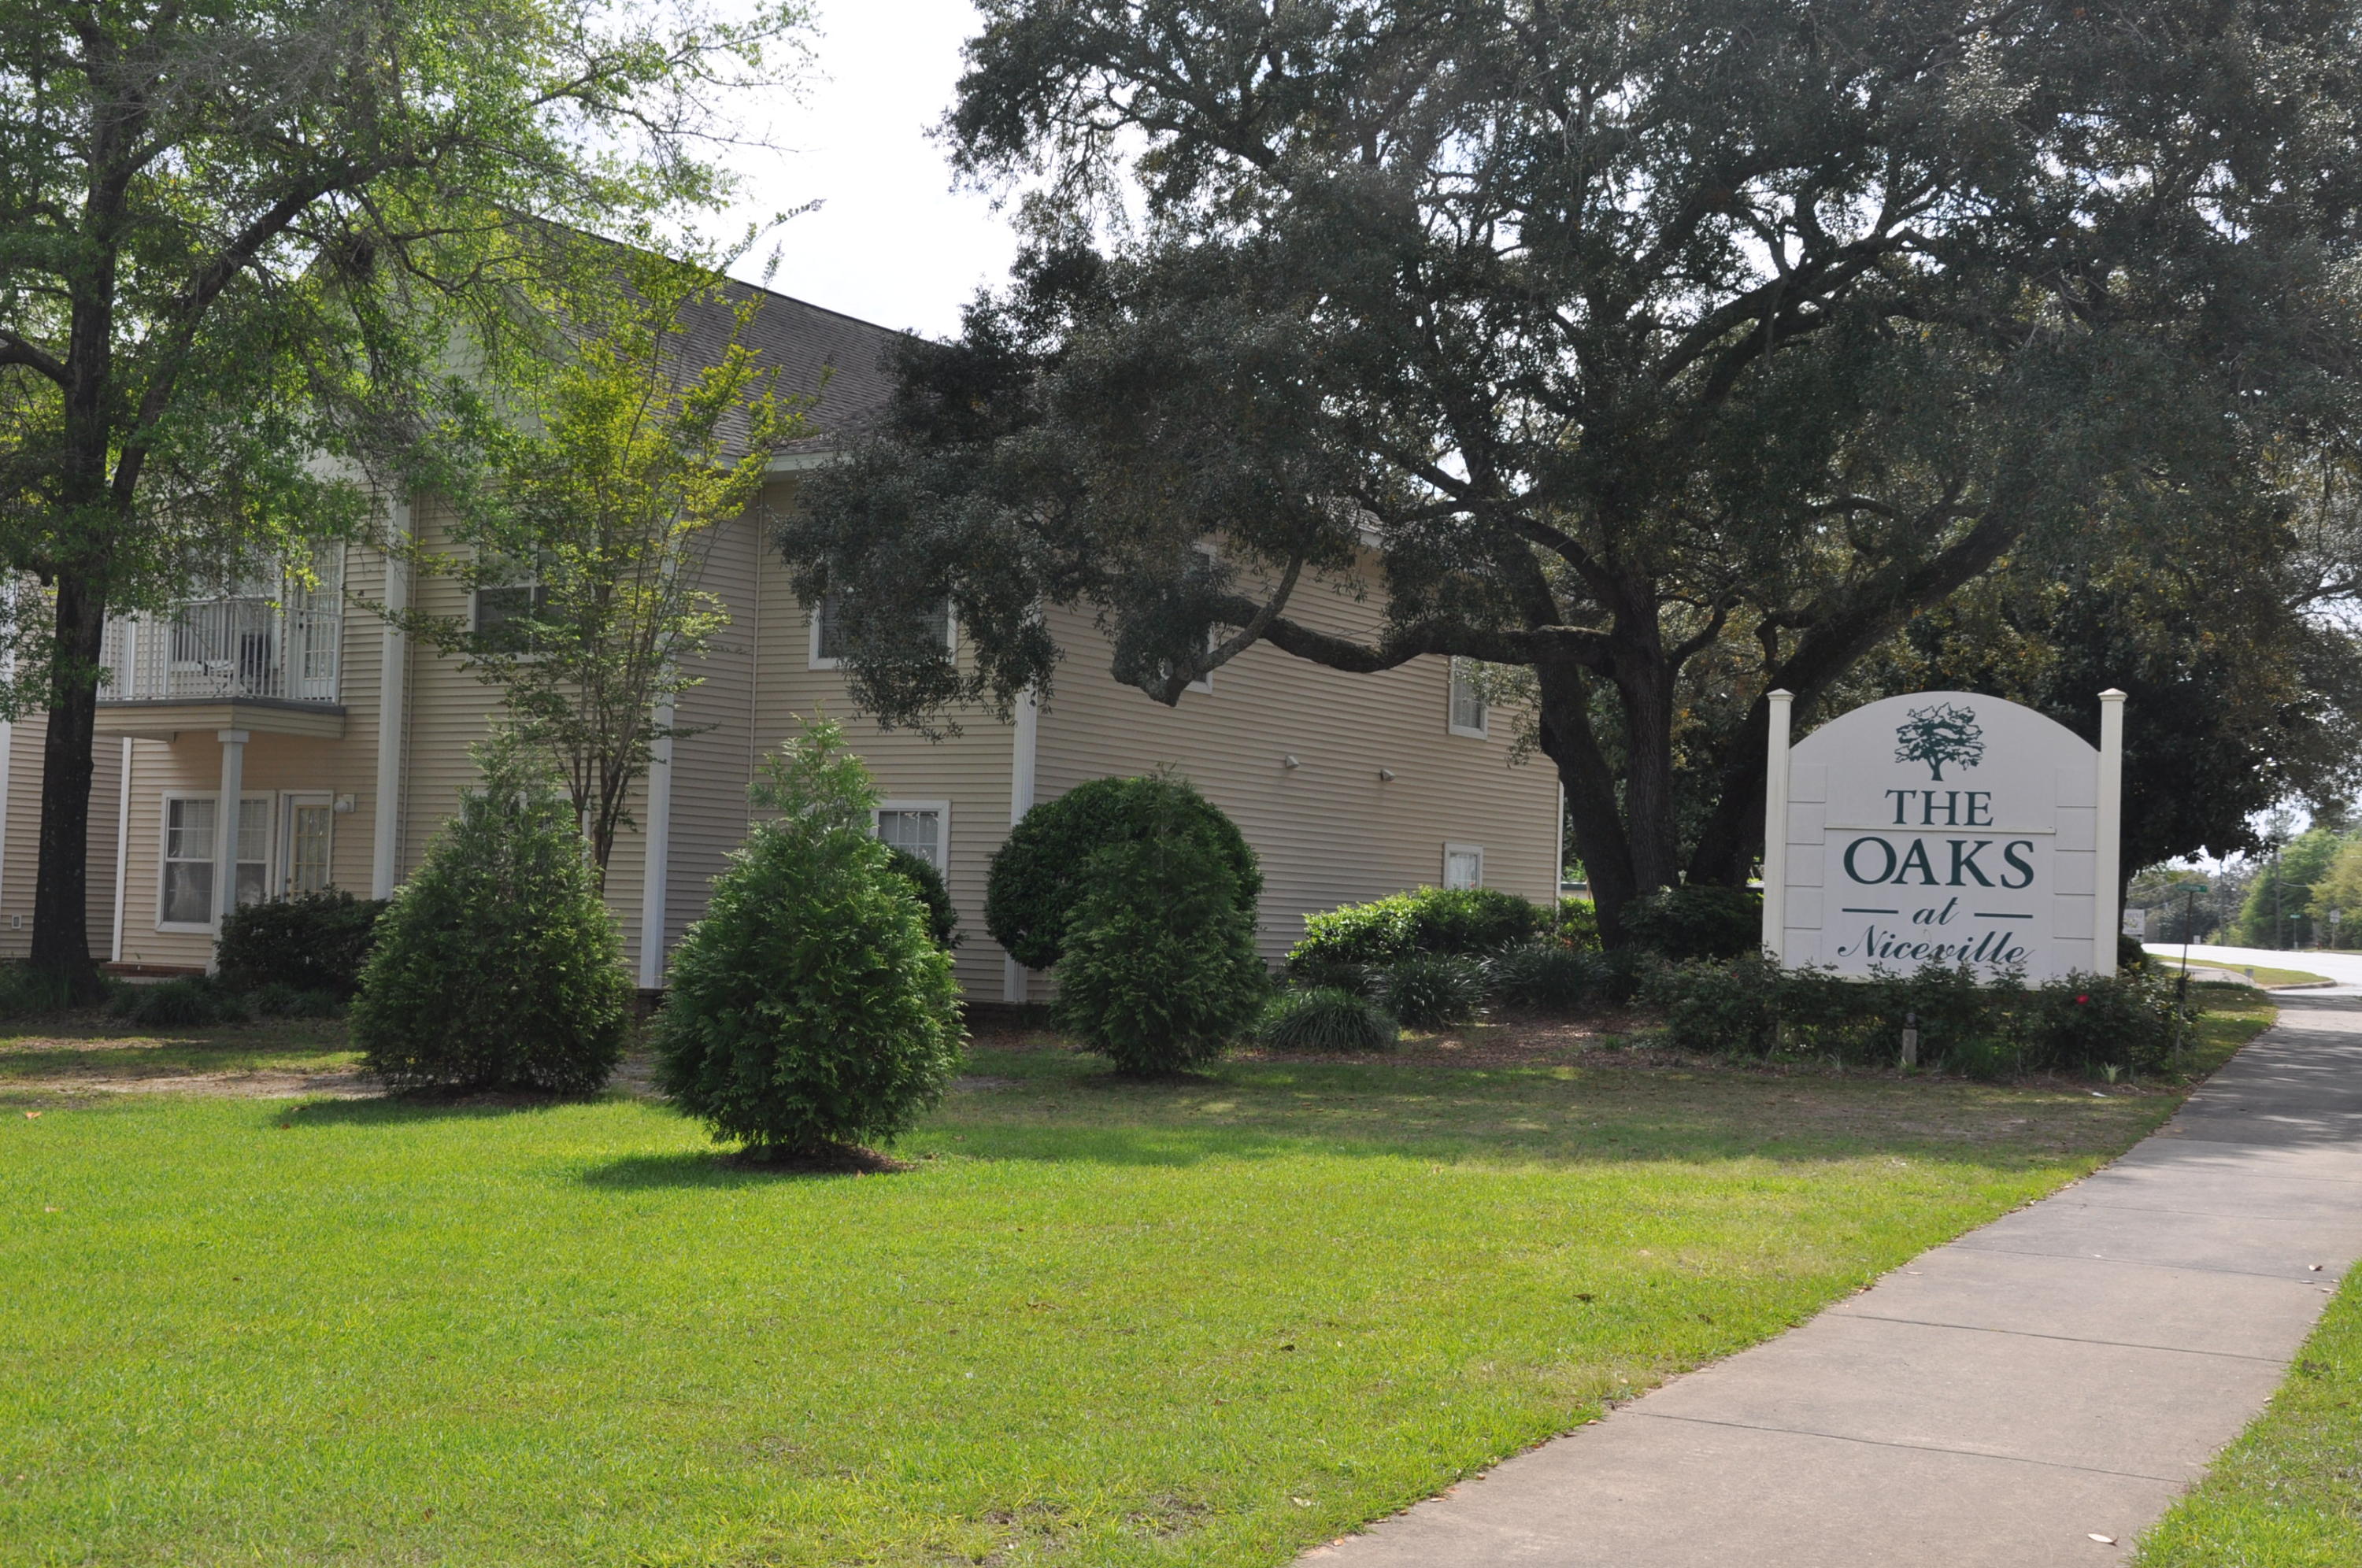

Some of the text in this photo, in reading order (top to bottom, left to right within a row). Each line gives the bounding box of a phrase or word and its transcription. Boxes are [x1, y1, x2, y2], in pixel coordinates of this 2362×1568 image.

[1884, 790, 1994, 827] THE
[1843, 837, 2034, 889] OAKS
[1912, 897, 1960, 925] at
[1838, 925, 2035, 964] Niceville
